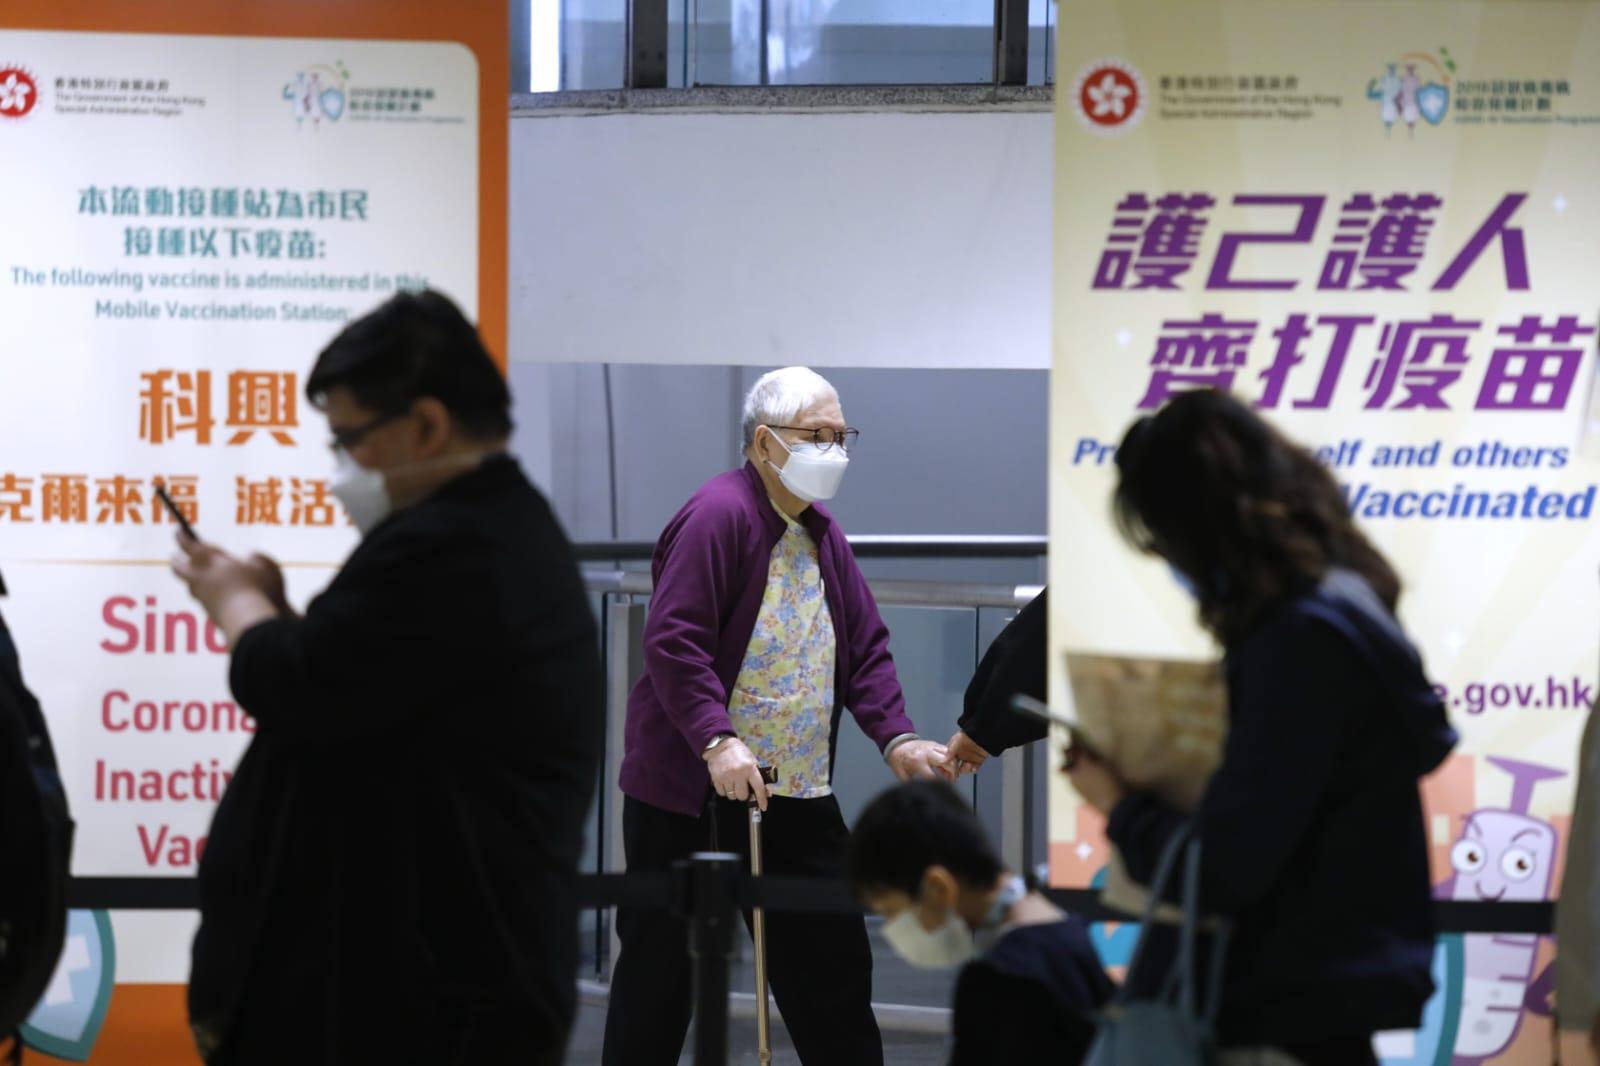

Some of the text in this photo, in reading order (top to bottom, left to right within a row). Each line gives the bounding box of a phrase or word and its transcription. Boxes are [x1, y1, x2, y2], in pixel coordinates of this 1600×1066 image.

[79, 186, 369, 221] 本流動接種站為市民
[1091, 191, 1530, 290] 護己護人
[12, 267, 46, 286] The
[51, 268, 143, 292] following
[148, 272, 220, 289] vaccine
[224, 269, 241, 289] is
[245, 269, 369, 291] administered
[373, 270, 392, 290] in
[95, 299, 160, 319] Mobile
[165, 300, 276, 321] Vaccination
[1136, 313, 1596, 412] 齊打疫苗
[139, 370, 299, 447] 科興
[1371, 440, 1441, 467] and
[1452, 441, 1568, 467] others
[236, 475, 357, 526] 滅活
[95, 759, 233, 802] Inacti
